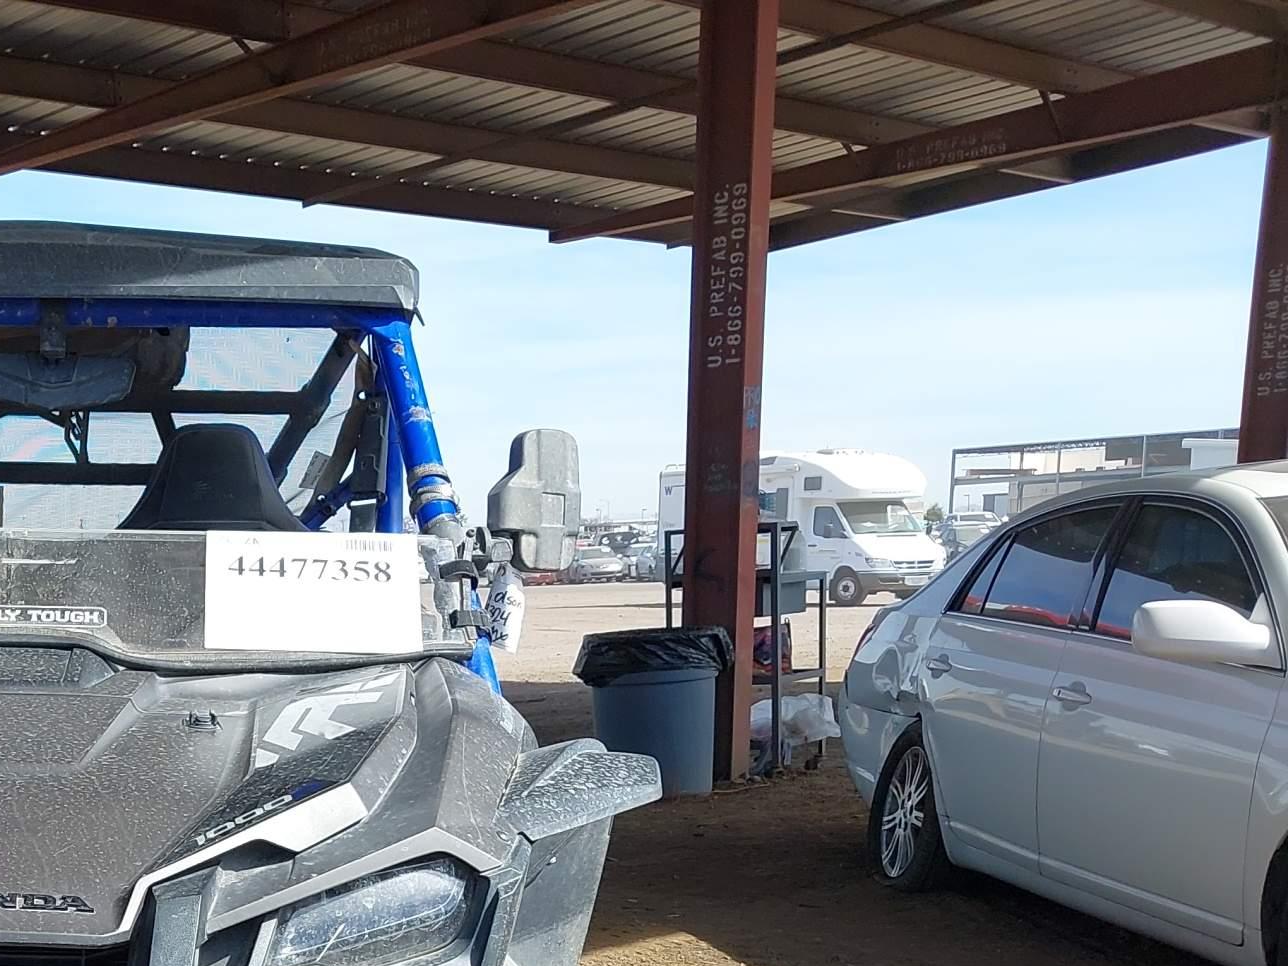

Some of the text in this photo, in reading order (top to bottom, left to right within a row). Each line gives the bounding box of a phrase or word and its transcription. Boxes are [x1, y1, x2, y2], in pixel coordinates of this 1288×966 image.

[713, 183, 730, 225] INC.
[709, 235, 728, 317] PREFAB
[725, 182, 748, 365] 1-866-799-0969
[1261, 300, 1280, 360] PREFAB
[227, 555, 392, 583] 44477358
[26, 609, 100, 624] TOUGH
[194, 794, 293, 845] 1000
